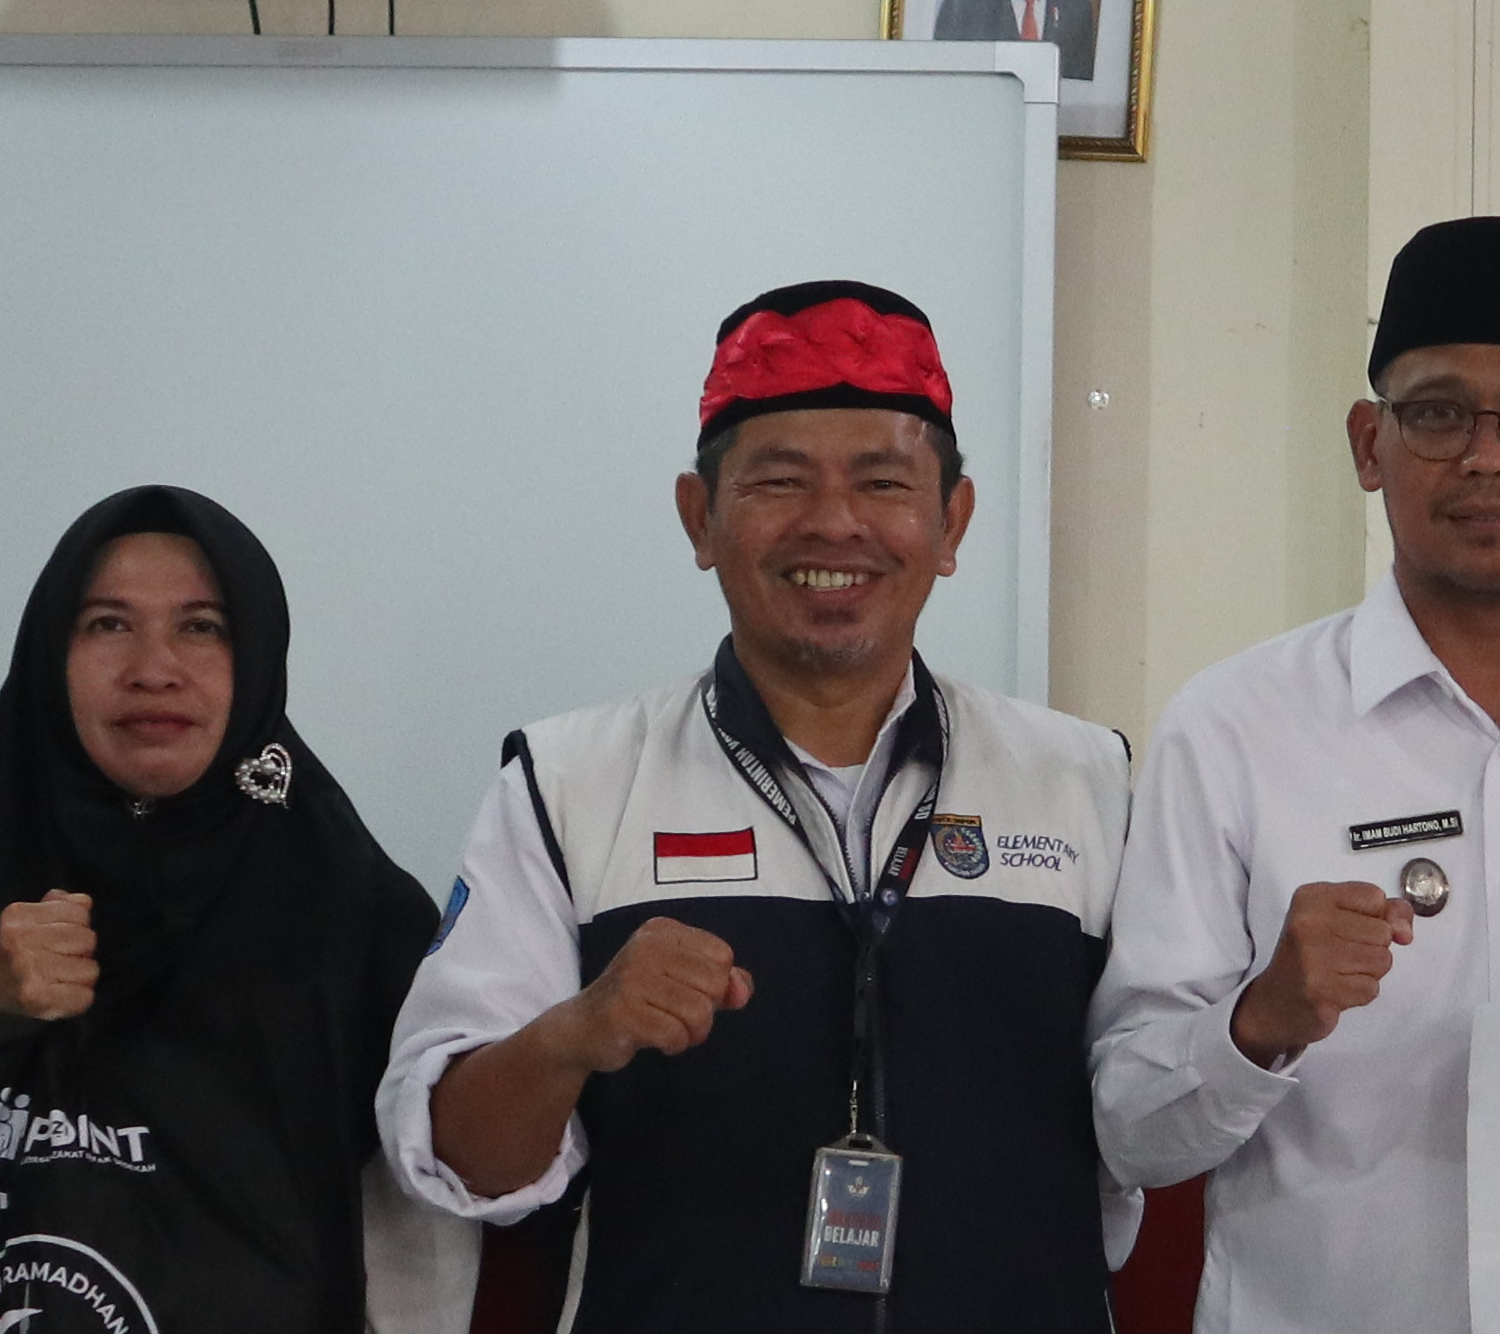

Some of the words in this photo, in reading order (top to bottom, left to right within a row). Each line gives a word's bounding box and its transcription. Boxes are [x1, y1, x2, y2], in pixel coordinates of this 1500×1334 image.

[736, 746, 799, 826] PEMERINTAH
[1362, 828, 1383, 841] IMAM
[1383, 825, 1402, 838] BUDI
[1402, 819, 1443, 835] HARTONO,
[997, 835, 1080, 865] ELEMENTARY
[1000, 852, 1062, 872] SCHOOL
[823, 1225, 879, 1248] BELAJAR
